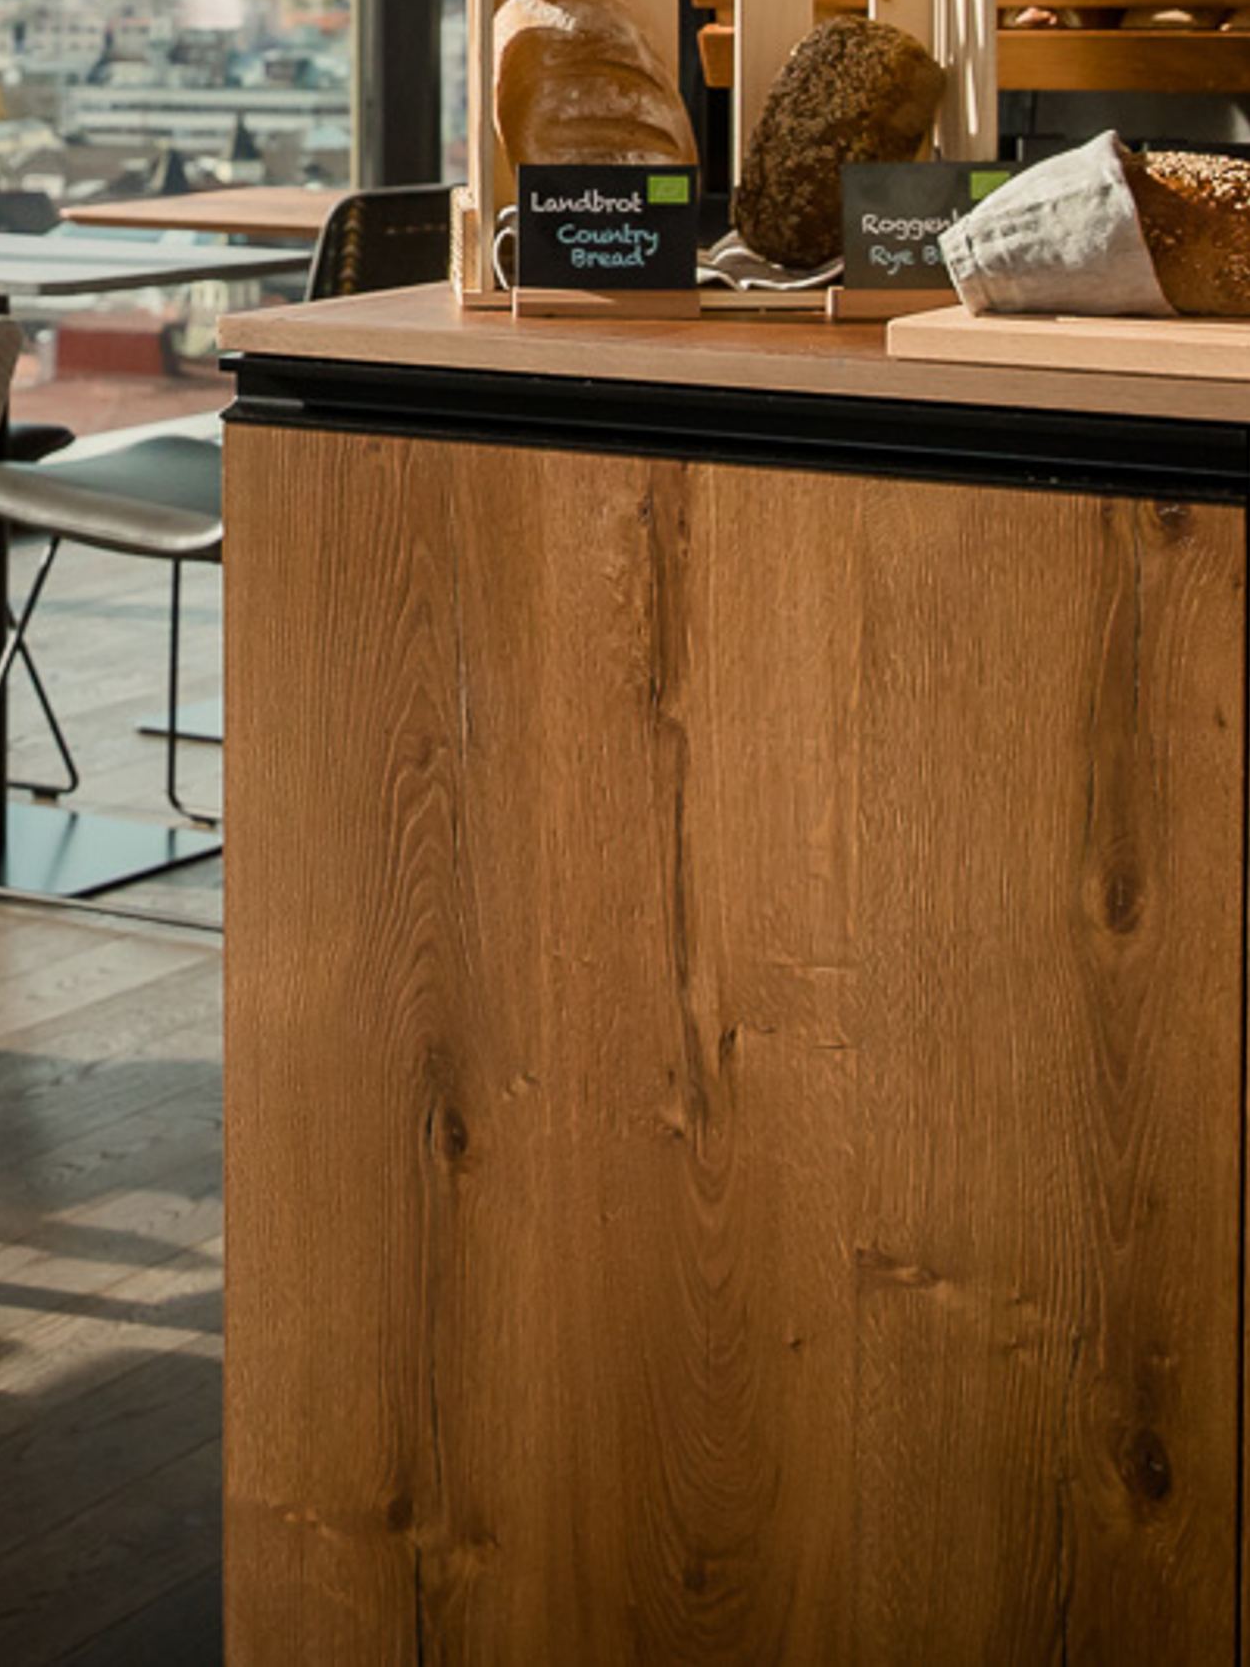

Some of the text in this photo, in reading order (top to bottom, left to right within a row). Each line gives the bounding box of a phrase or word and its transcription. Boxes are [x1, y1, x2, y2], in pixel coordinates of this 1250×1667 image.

[530, 189, 643, 213] Landbrot
[556, 223, 658, 256] Country
[571, 245, 645, 268] Bread
[869, 244, 915, 276] Rye
